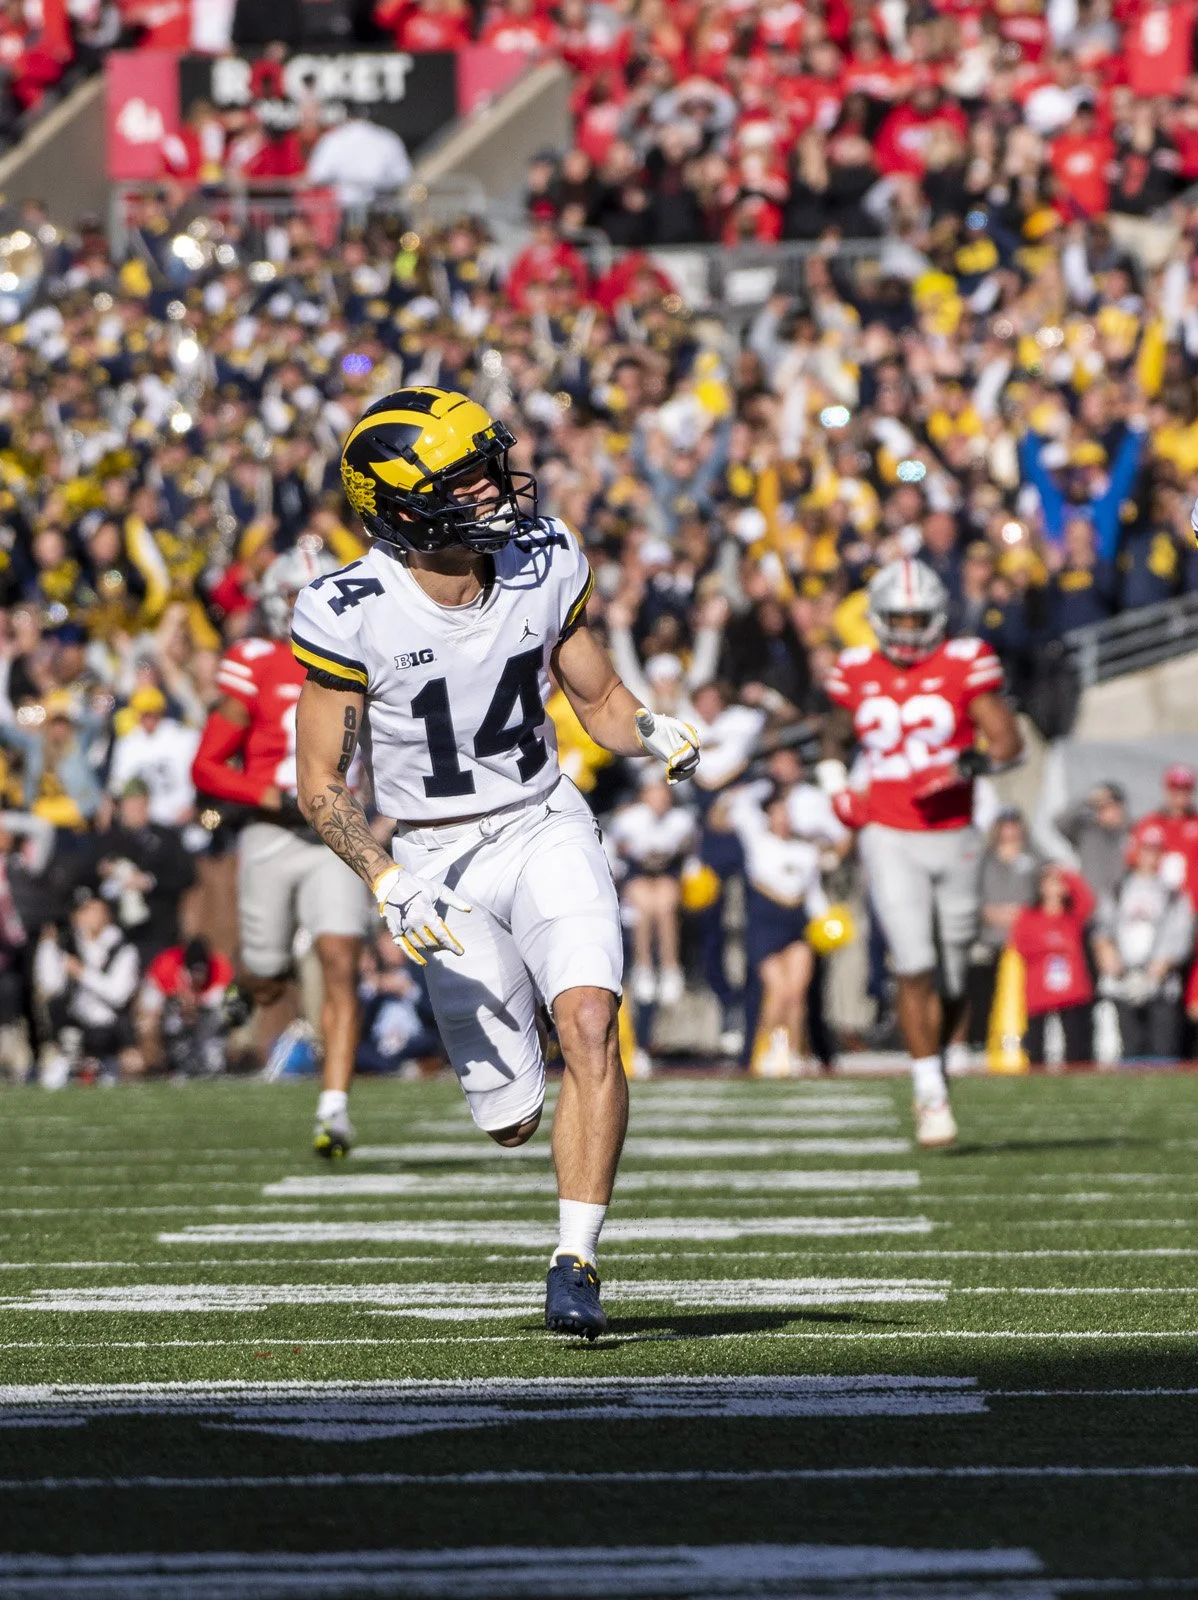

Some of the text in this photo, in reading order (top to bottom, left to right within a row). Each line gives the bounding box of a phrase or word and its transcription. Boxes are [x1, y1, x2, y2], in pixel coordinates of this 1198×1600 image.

[308, 560, 386, 617] 14
[410, 645, 549, 798] 14
[854, 694, 959, 780] 22
